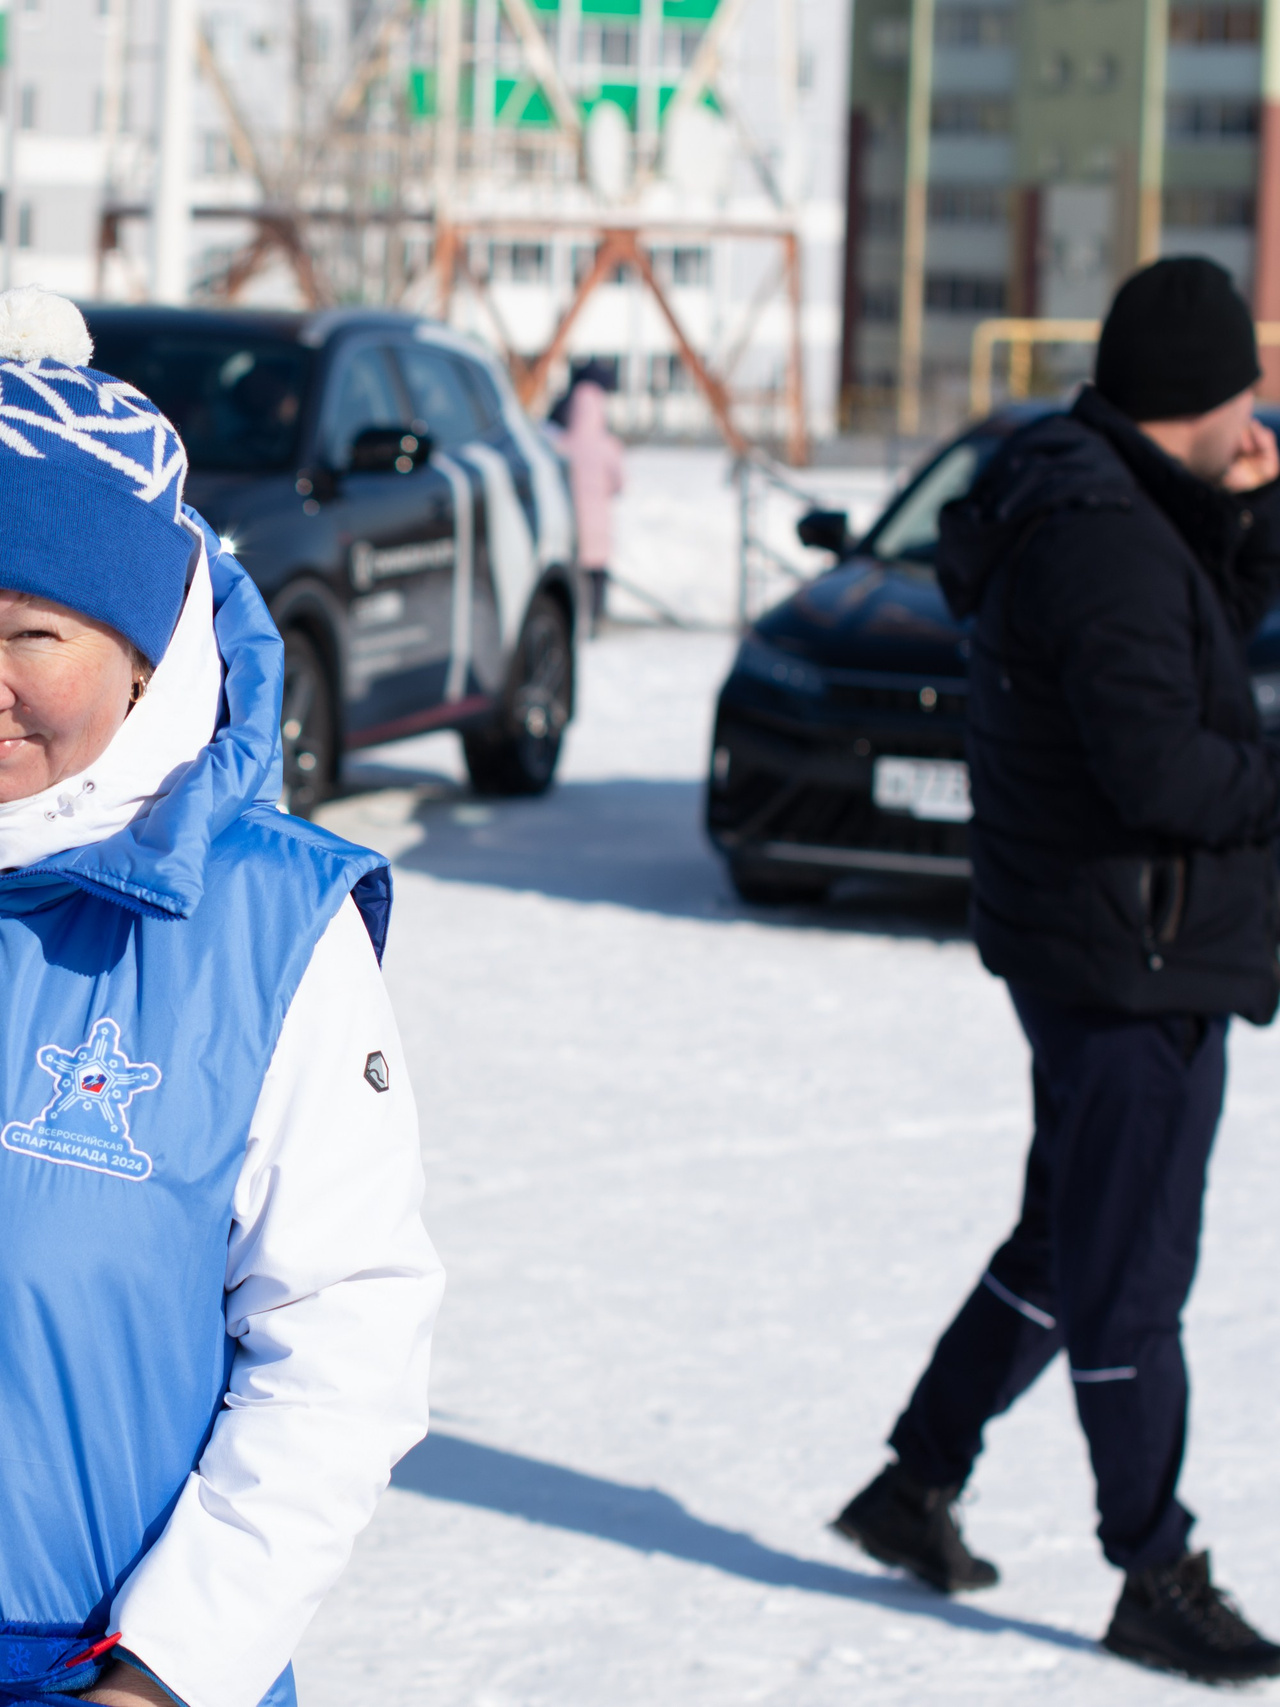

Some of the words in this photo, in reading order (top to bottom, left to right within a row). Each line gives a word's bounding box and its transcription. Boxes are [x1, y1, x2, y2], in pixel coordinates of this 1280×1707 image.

[11, 1130, 108, 1163] СПАРТАКИАДА
[110, 1154, 143, 1173] 2024
[37, 1125, 124, 1152] ВСЕРОССИЙСКАЯ
